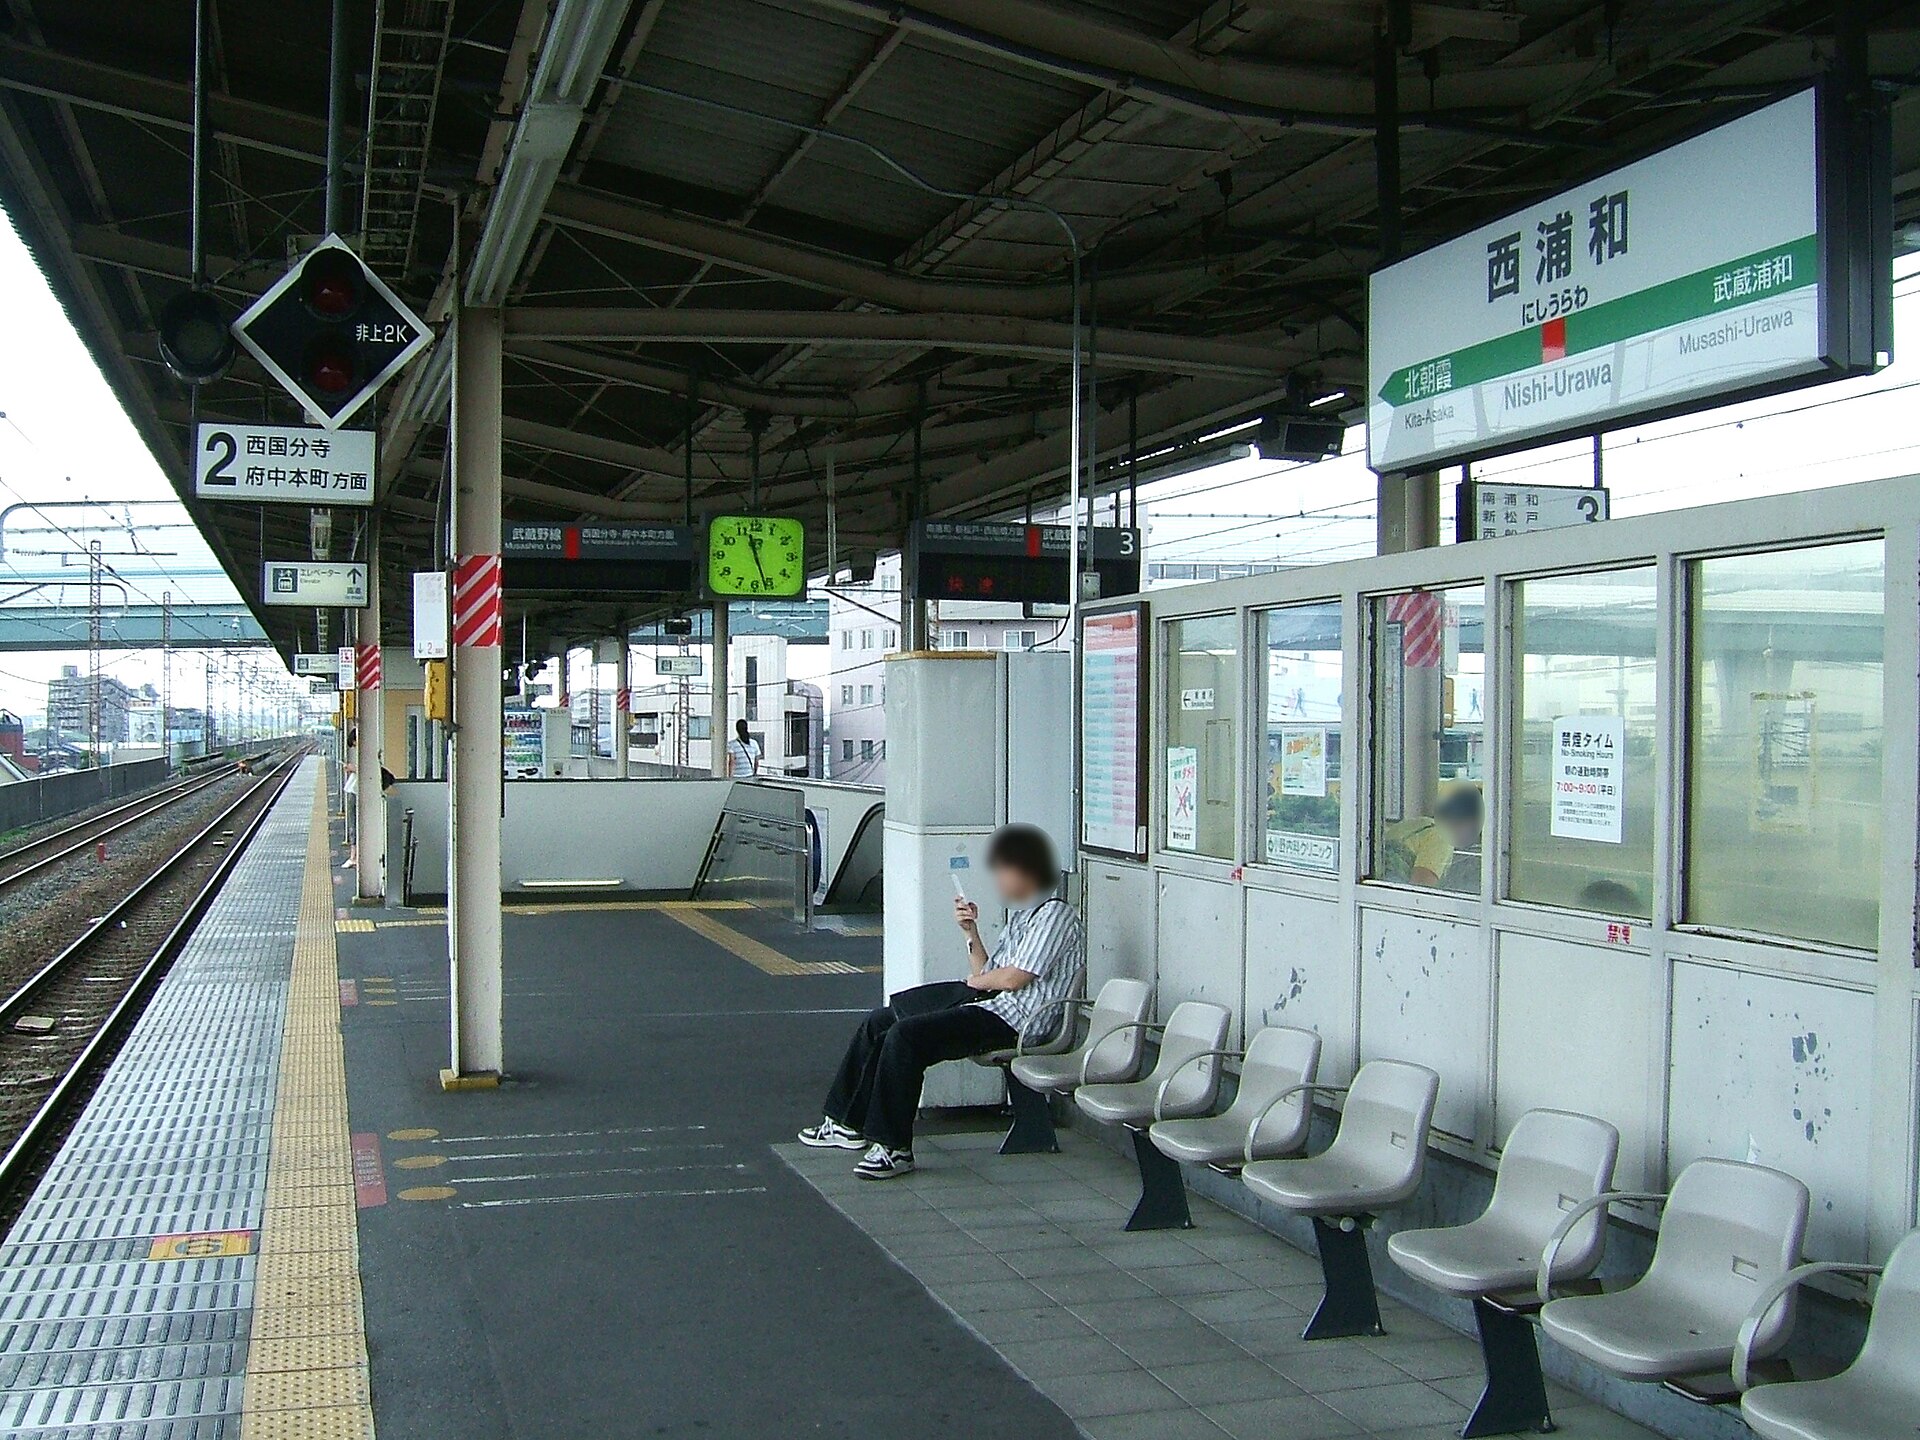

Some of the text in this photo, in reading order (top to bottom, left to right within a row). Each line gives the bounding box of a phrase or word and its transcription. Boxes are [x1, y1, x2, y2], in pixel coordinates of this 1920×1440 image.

[1486, 190, 1630, 303] 西浦和
[1712, 255, 1794, 304] 武蔵浦和
[1521, 286, 1590, 326] にしうらわ
[355, 324, 409, 344] 非上2K
[1678, 308, 1794, 356] Musashi-Urawa
[1403, 360, 1453, 400] 北朝霞
[1503, 361, 1613, 411] Nishi-Urawa
[1404, 404, 1455, 430] Kita-Asaka
[246, 435, 331, 458] 西国分寺
[204, 431, 238, 487] 2
[245, 466, 368, 491] 府中本町方面
[1482, 492, 1539, 507] 南浦和
[1482, 510, 1539, 524] 新松戸
[723, 536, 736, 546] 10
[736, 527, 748, 536] 11
[1120, 532, 1134, 555] 3
[716, 550, 726, 560] 9
[786, 552, 795, 562] 3
[722, 566, 732, 576] 8
[736, 576, 745, 587] 7
[750, 580, 760, 590] 6
[1561, 731, 1614, 749] 禁煙タイム
[1561, 748, 1595, 760] No-Smoking
